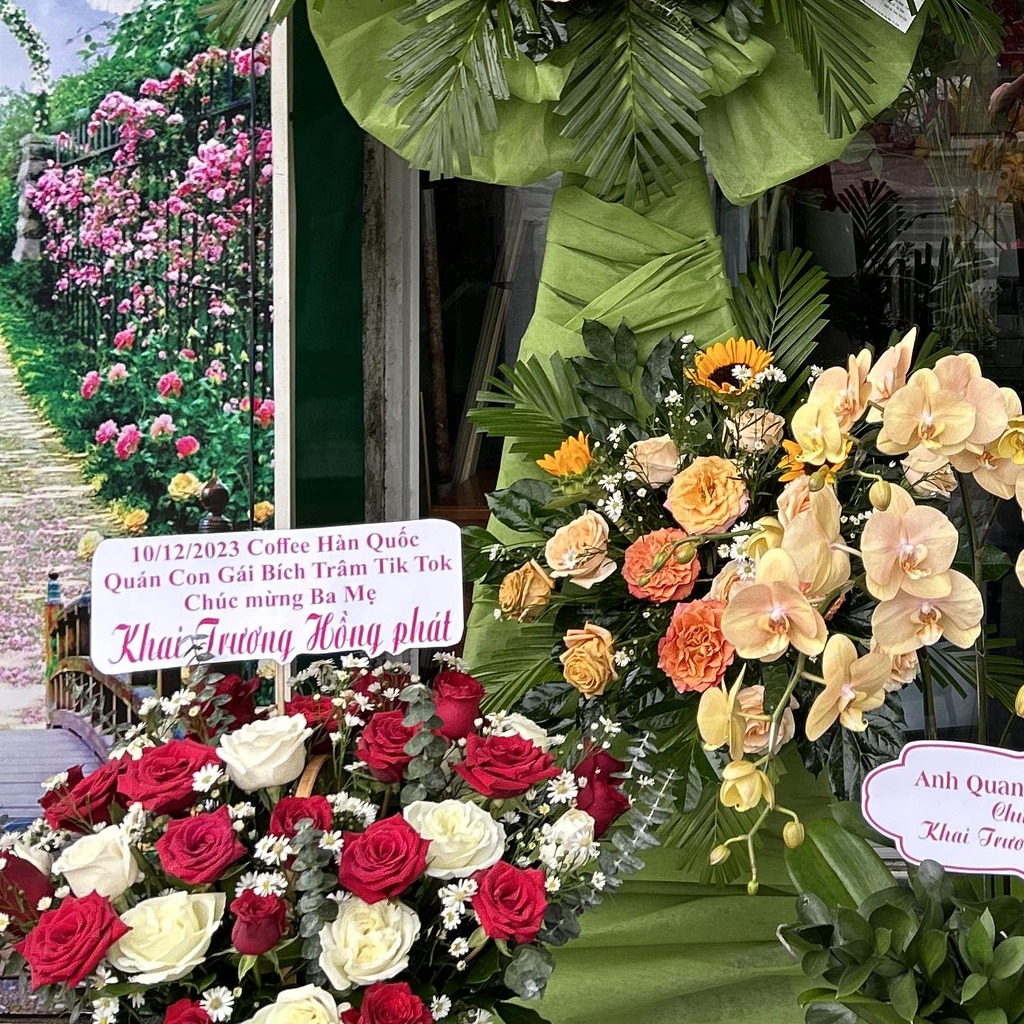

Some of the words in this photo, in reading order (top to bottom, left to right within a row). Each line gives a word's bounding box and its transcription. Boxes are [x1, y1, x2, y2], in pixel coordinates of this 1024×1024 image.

[131, 539, 240, 563] 10/12/2023
[247, 536, 311, 556] Coffee
[317, 531, 359, 553] Hàn
[366, 527, 420, 551] Quốc
[104, 566, 162, 593] Quán
[168, 565, 211, 587] Con
[217, 560, 254, 584] Gái
[261, 557, 306, 582] Bích
[312, 556, 368, 579] Trâm
[373, 555, 409, 575] Tik
[413, 553, 454, 573] Tok
[183, 590, 239, 613] Chúc
[245, 588, 305, 611] mừng
[310, 587, 338, 607] Ba
[344, 583, 378, 606] Mẹ
[107, 622, 184, 665] Khai
[196, 617, 296, 663] Trương
[305, 610, 384, 655] Hồng
[391, 605, 453, 654] phát
[914, 770, 959, 791] Anh
[917, 819, 970, 846] Khai
